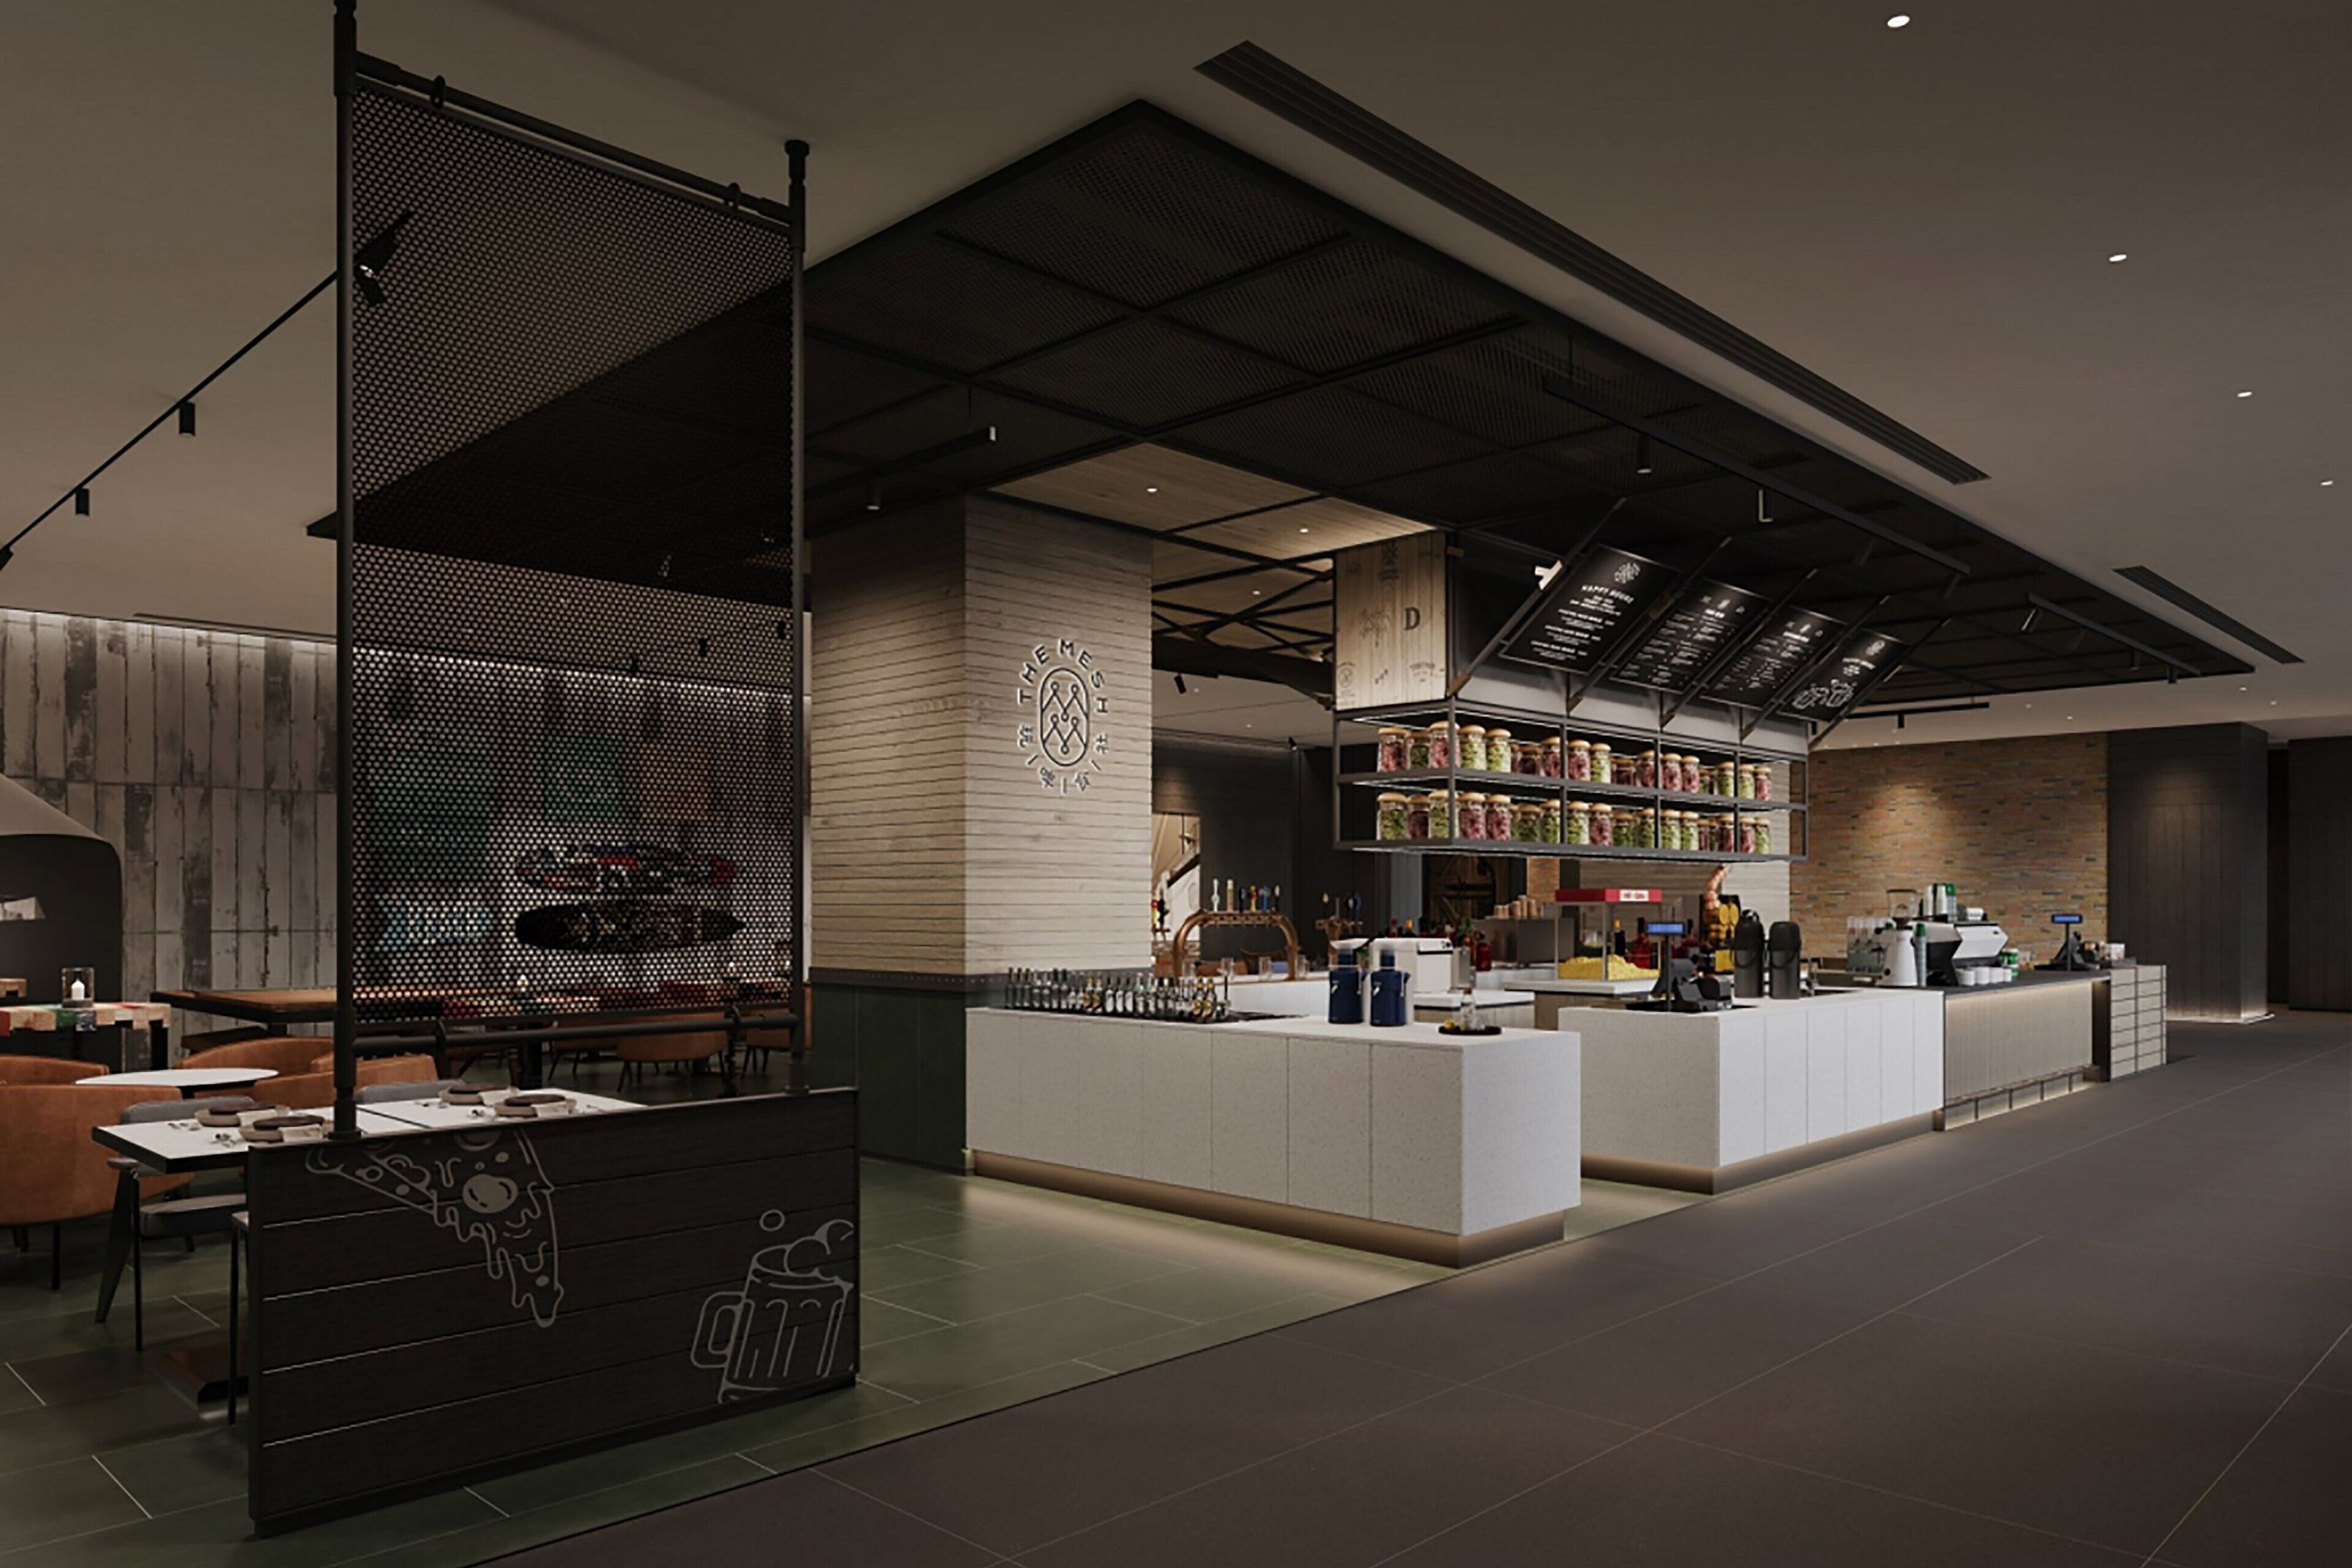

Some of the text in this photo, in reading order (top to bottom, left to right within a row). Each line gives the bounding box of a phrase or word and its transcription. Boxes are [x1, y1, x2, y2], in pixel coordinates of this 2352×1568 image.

[1404, 607, 1420, 631] D
[1017, 638, 1109, 714] THE MESH
